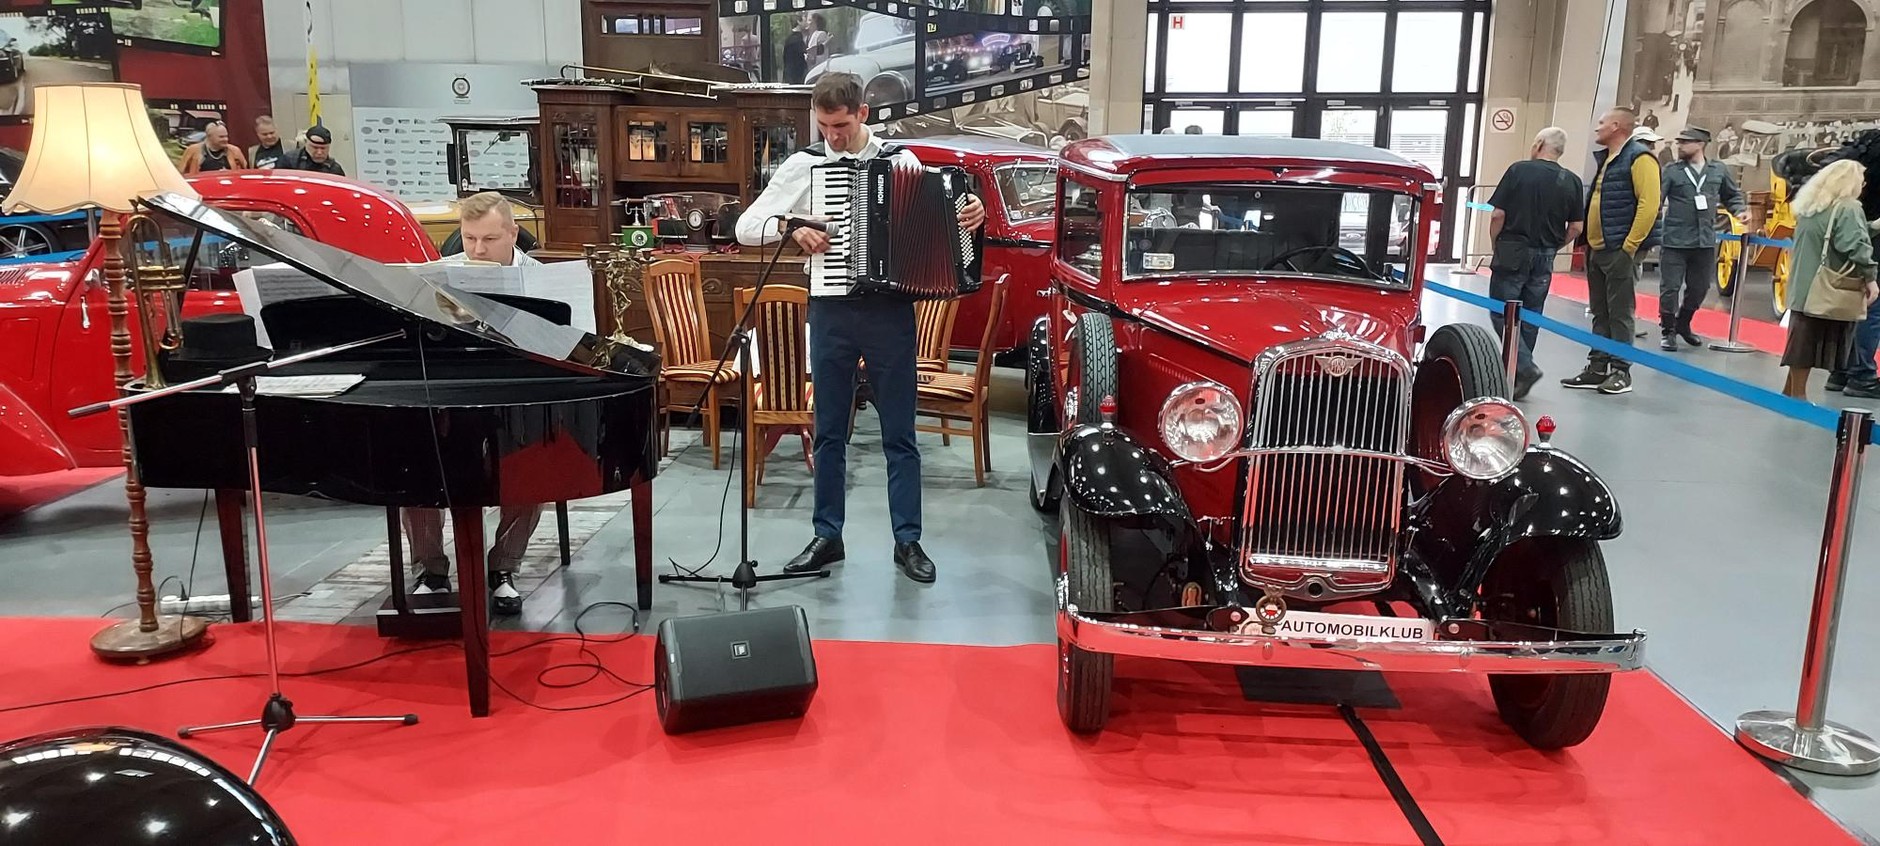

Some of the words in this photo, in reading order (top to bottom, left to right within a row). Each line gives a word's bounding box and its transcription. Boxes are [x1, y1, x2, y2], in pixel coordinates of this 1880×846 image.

[1173, 16, 1183, 29] H
[877, 174, 885, 204] HOHNER
[1281, 619, 1424, 639] AUTOMOBILKLUB
